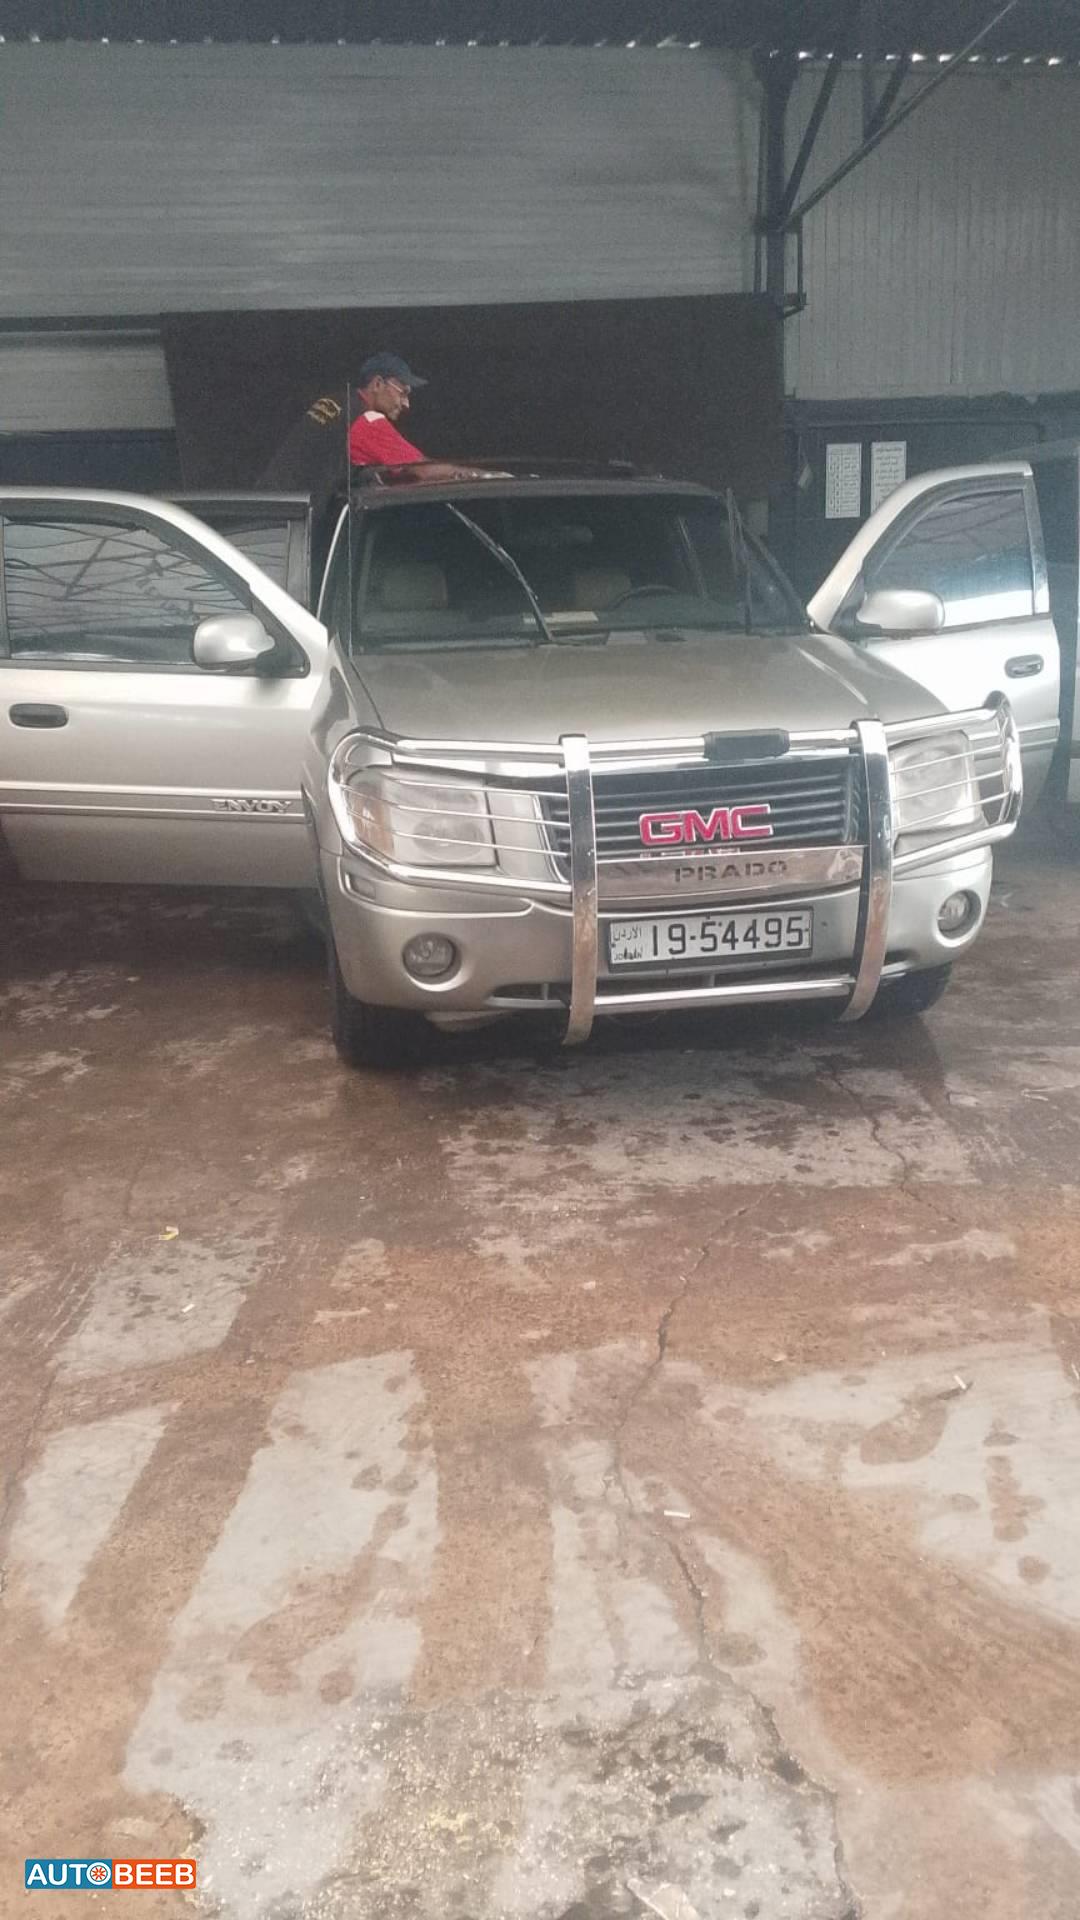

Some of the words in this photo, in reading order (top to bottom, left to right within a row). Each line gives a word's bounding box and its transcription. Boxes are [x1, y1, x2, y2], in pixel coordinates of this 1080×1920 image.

[211, 799, 292, 813] ENVOY
[640, 803, 774, 846] GMC
[675, 860, 788, 882] PRADO
[652, 916, 803, 956] 19-54495
